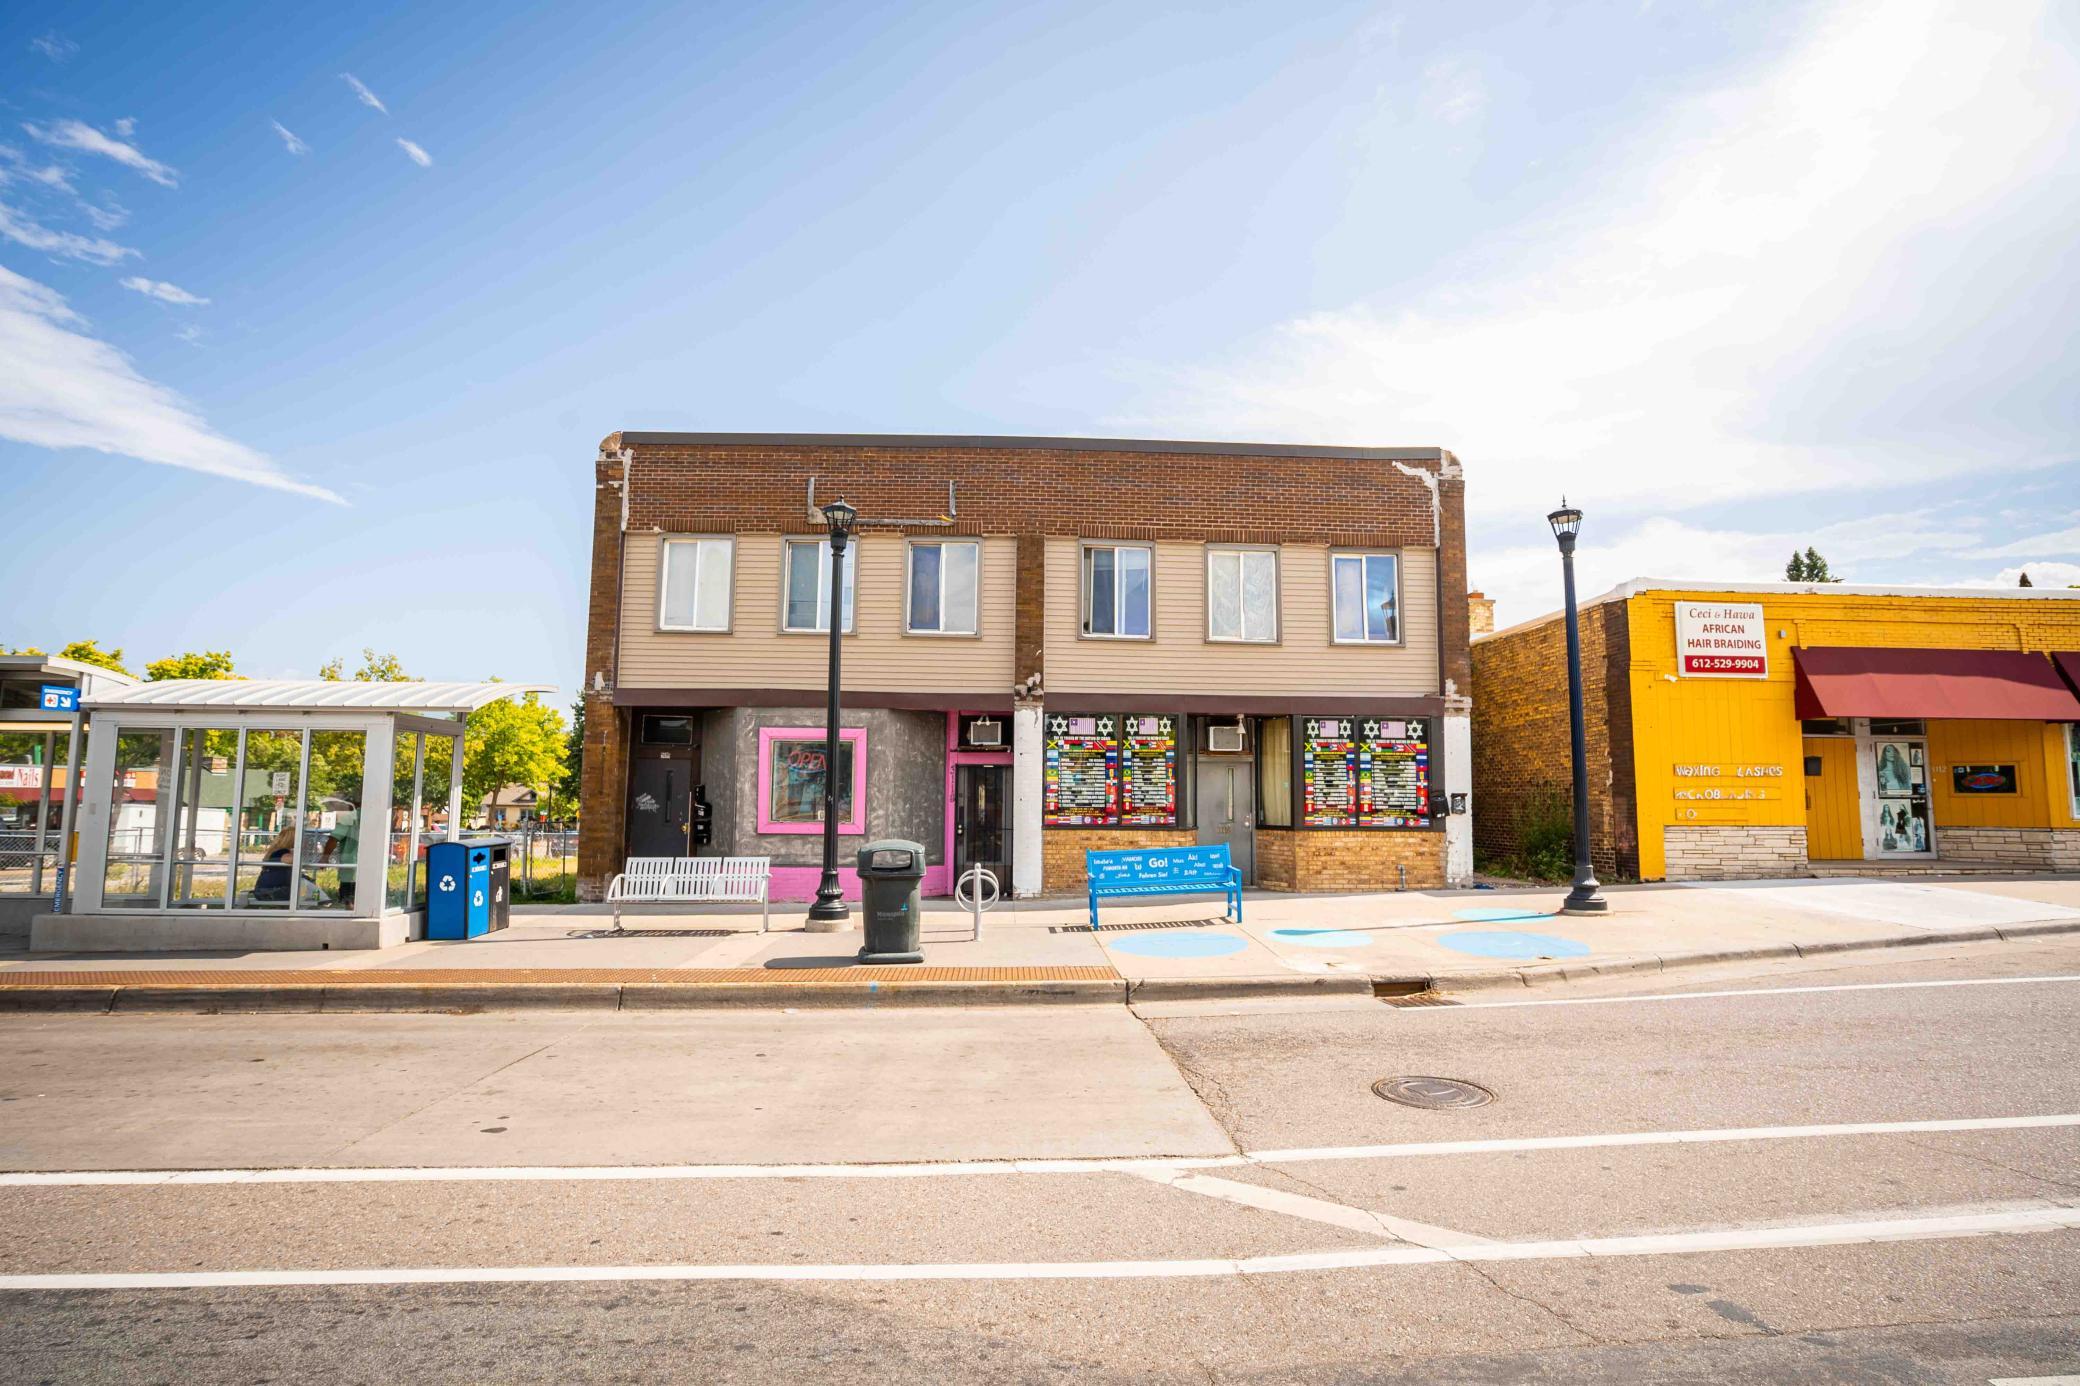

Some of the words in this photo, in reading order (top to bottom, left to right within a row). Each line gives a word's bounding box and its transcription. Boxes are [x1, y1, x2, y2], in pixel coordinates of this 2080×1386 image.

[1689, 608, 1711, 619] Ceci
[1724, 608, 1755, 619] Hawa
[1702, 624, 1745, 634] AFRICAN
[1687, 638, 1712, 648] HAIR
[1714, 639, 1761, 649] BRAIDING
[1691, 658, 1759, 669] 612-529-9904
[787, 750, 828, 770] OPEN
[16, 768, 39, 786] Nails
[1148, 857, 1168, 868] Go!
